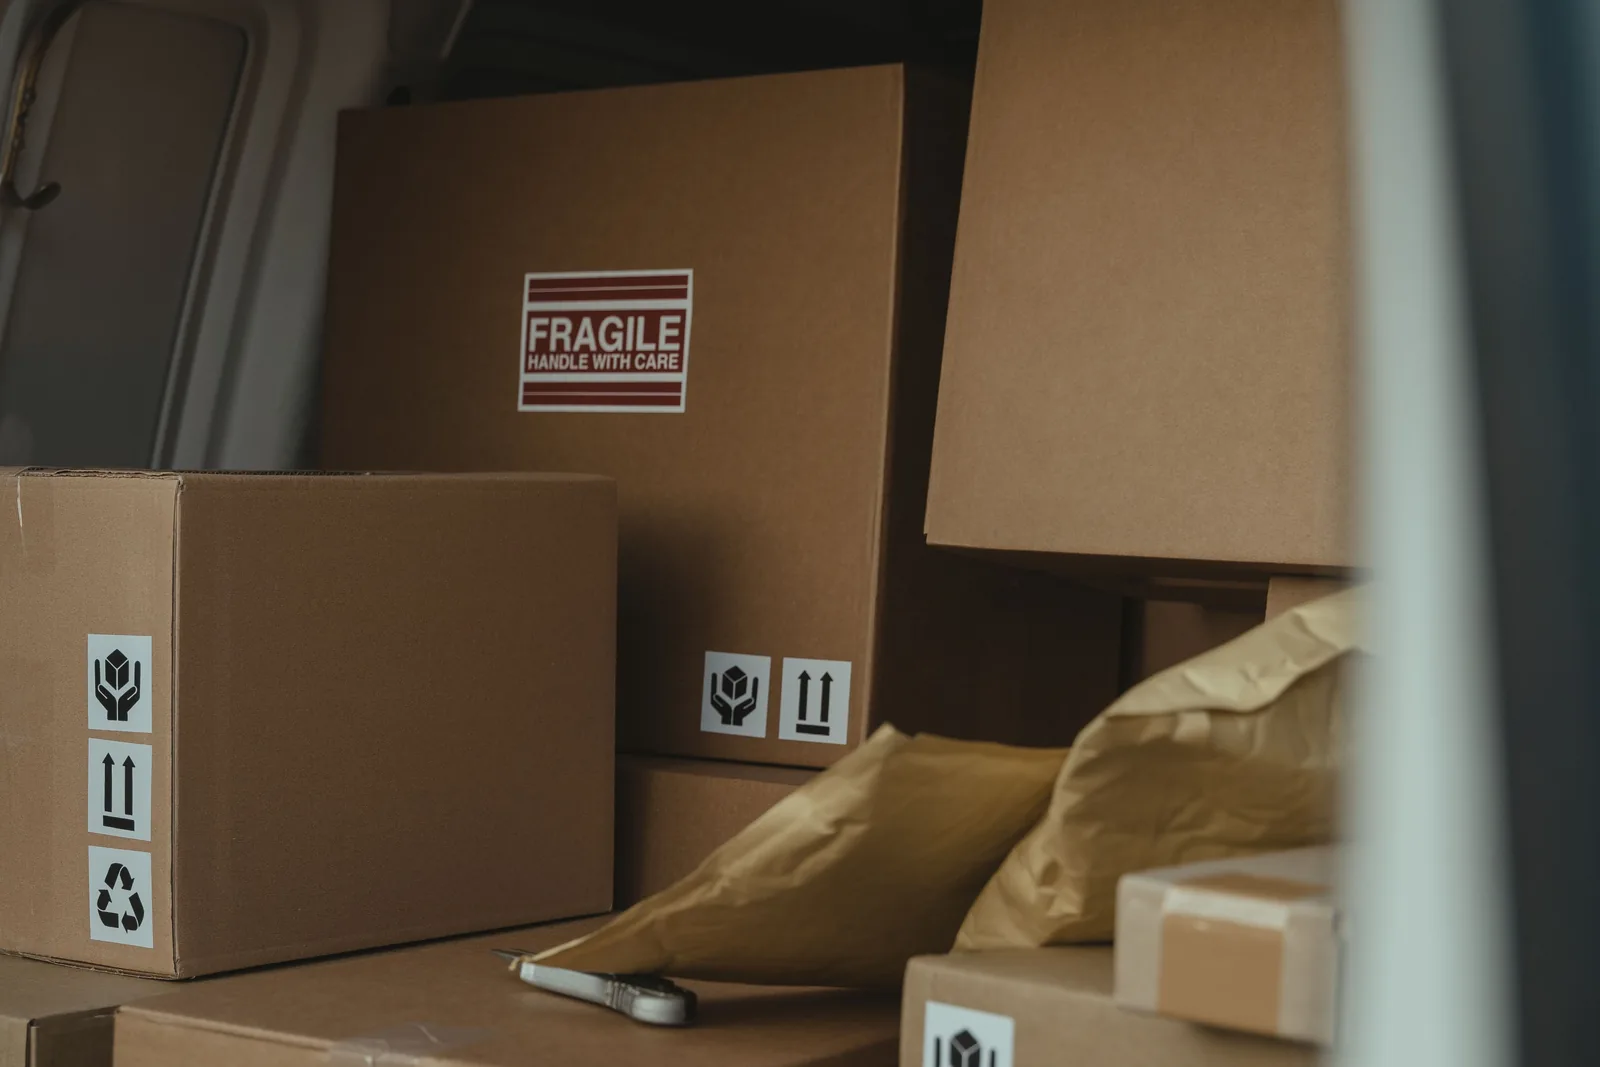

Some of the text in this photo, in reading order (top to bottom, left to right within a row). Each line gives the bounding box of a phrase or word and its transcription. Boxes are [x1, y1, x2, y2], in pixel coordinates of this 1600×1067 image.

[528, 315, 681, 352] FRAGILE
[527, 353, 679, 370] HANDLE WITH CARE
